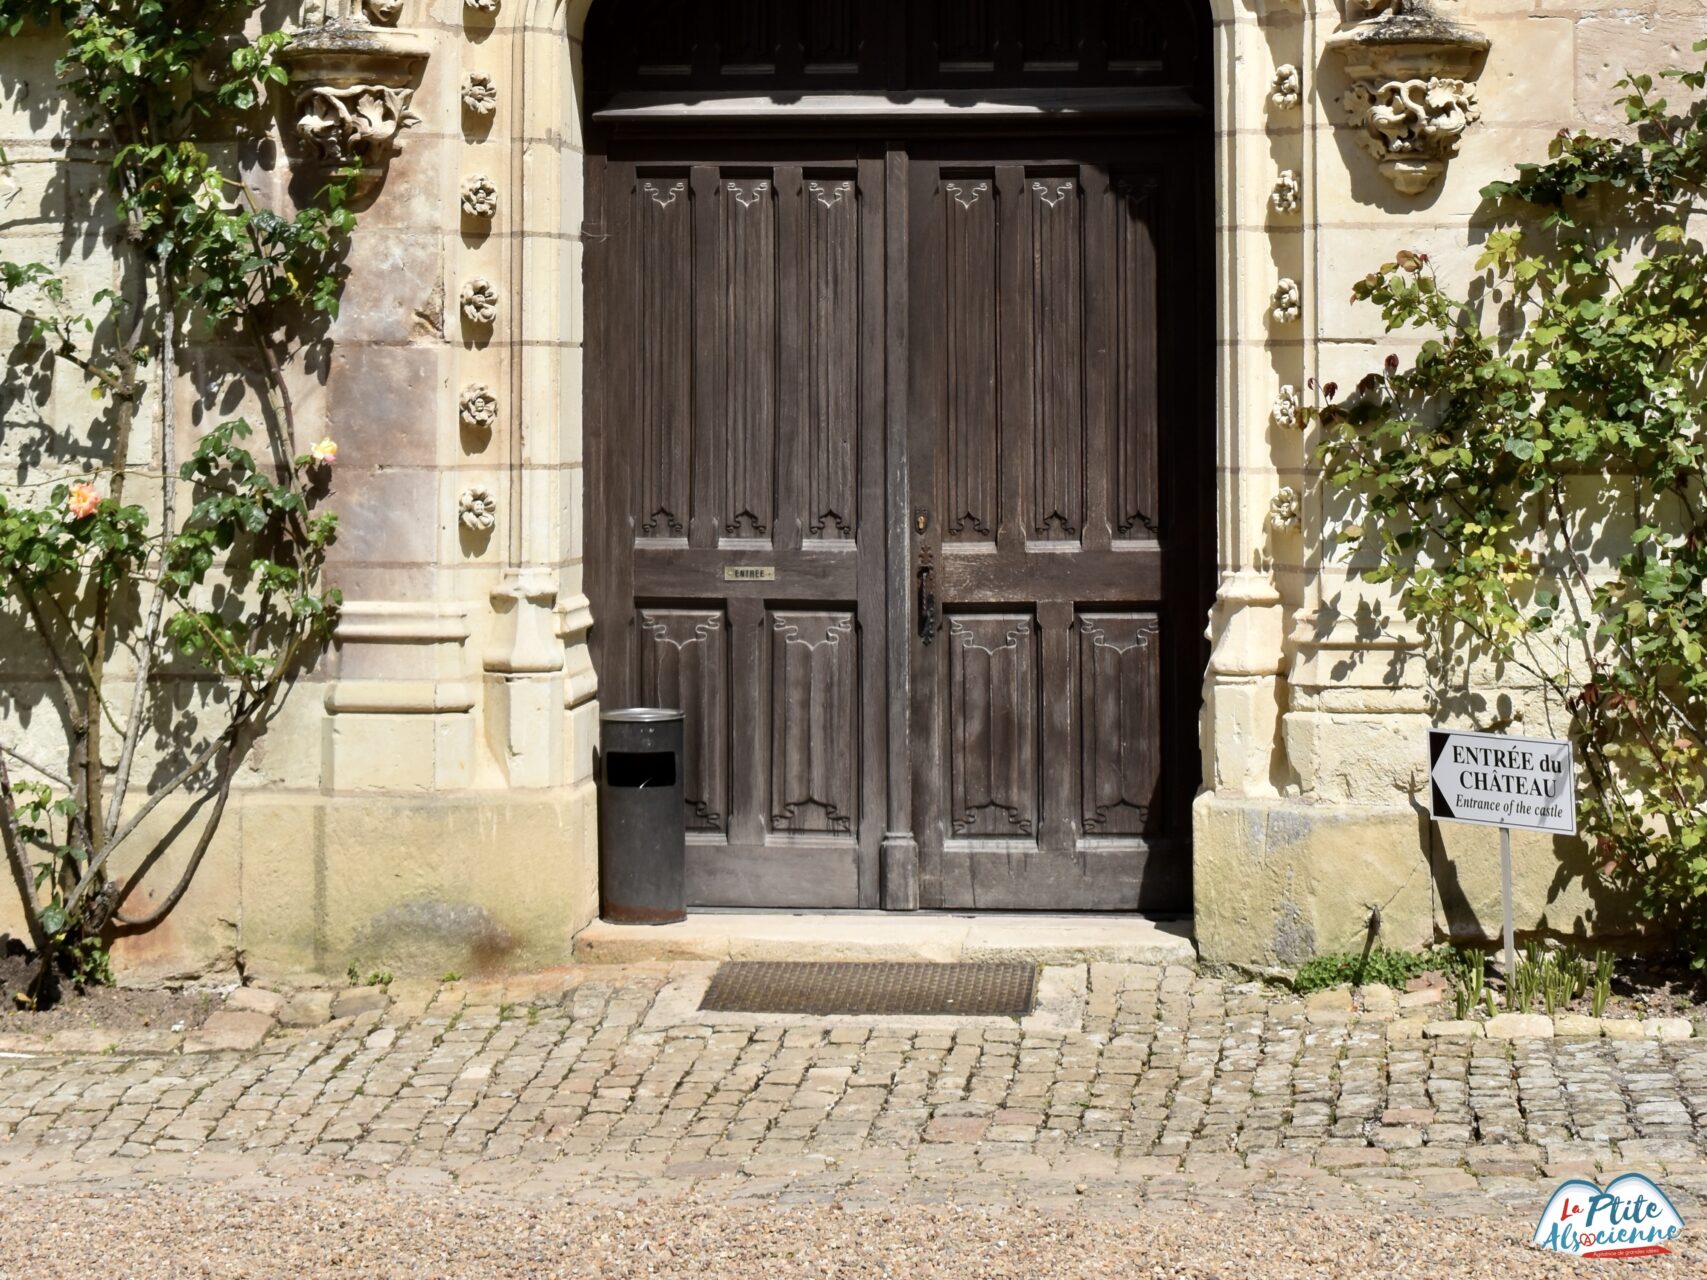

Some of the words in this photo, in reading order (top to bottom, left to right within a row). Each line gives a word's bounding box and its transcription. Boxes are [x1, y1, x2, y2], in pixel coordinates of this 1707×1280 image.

[1452, 745, 1534, 771] ENTRÉE
[1540, 754, 1562, 773] du
[1460, 769, 1556, 798] CHÂTEAU
[1456, 794, 1500, 811] Entrance
[1503, 800, 1515, 816] of
[1516, 802, 1531, 815] the
[1534, 804, 1563, 818] castle
